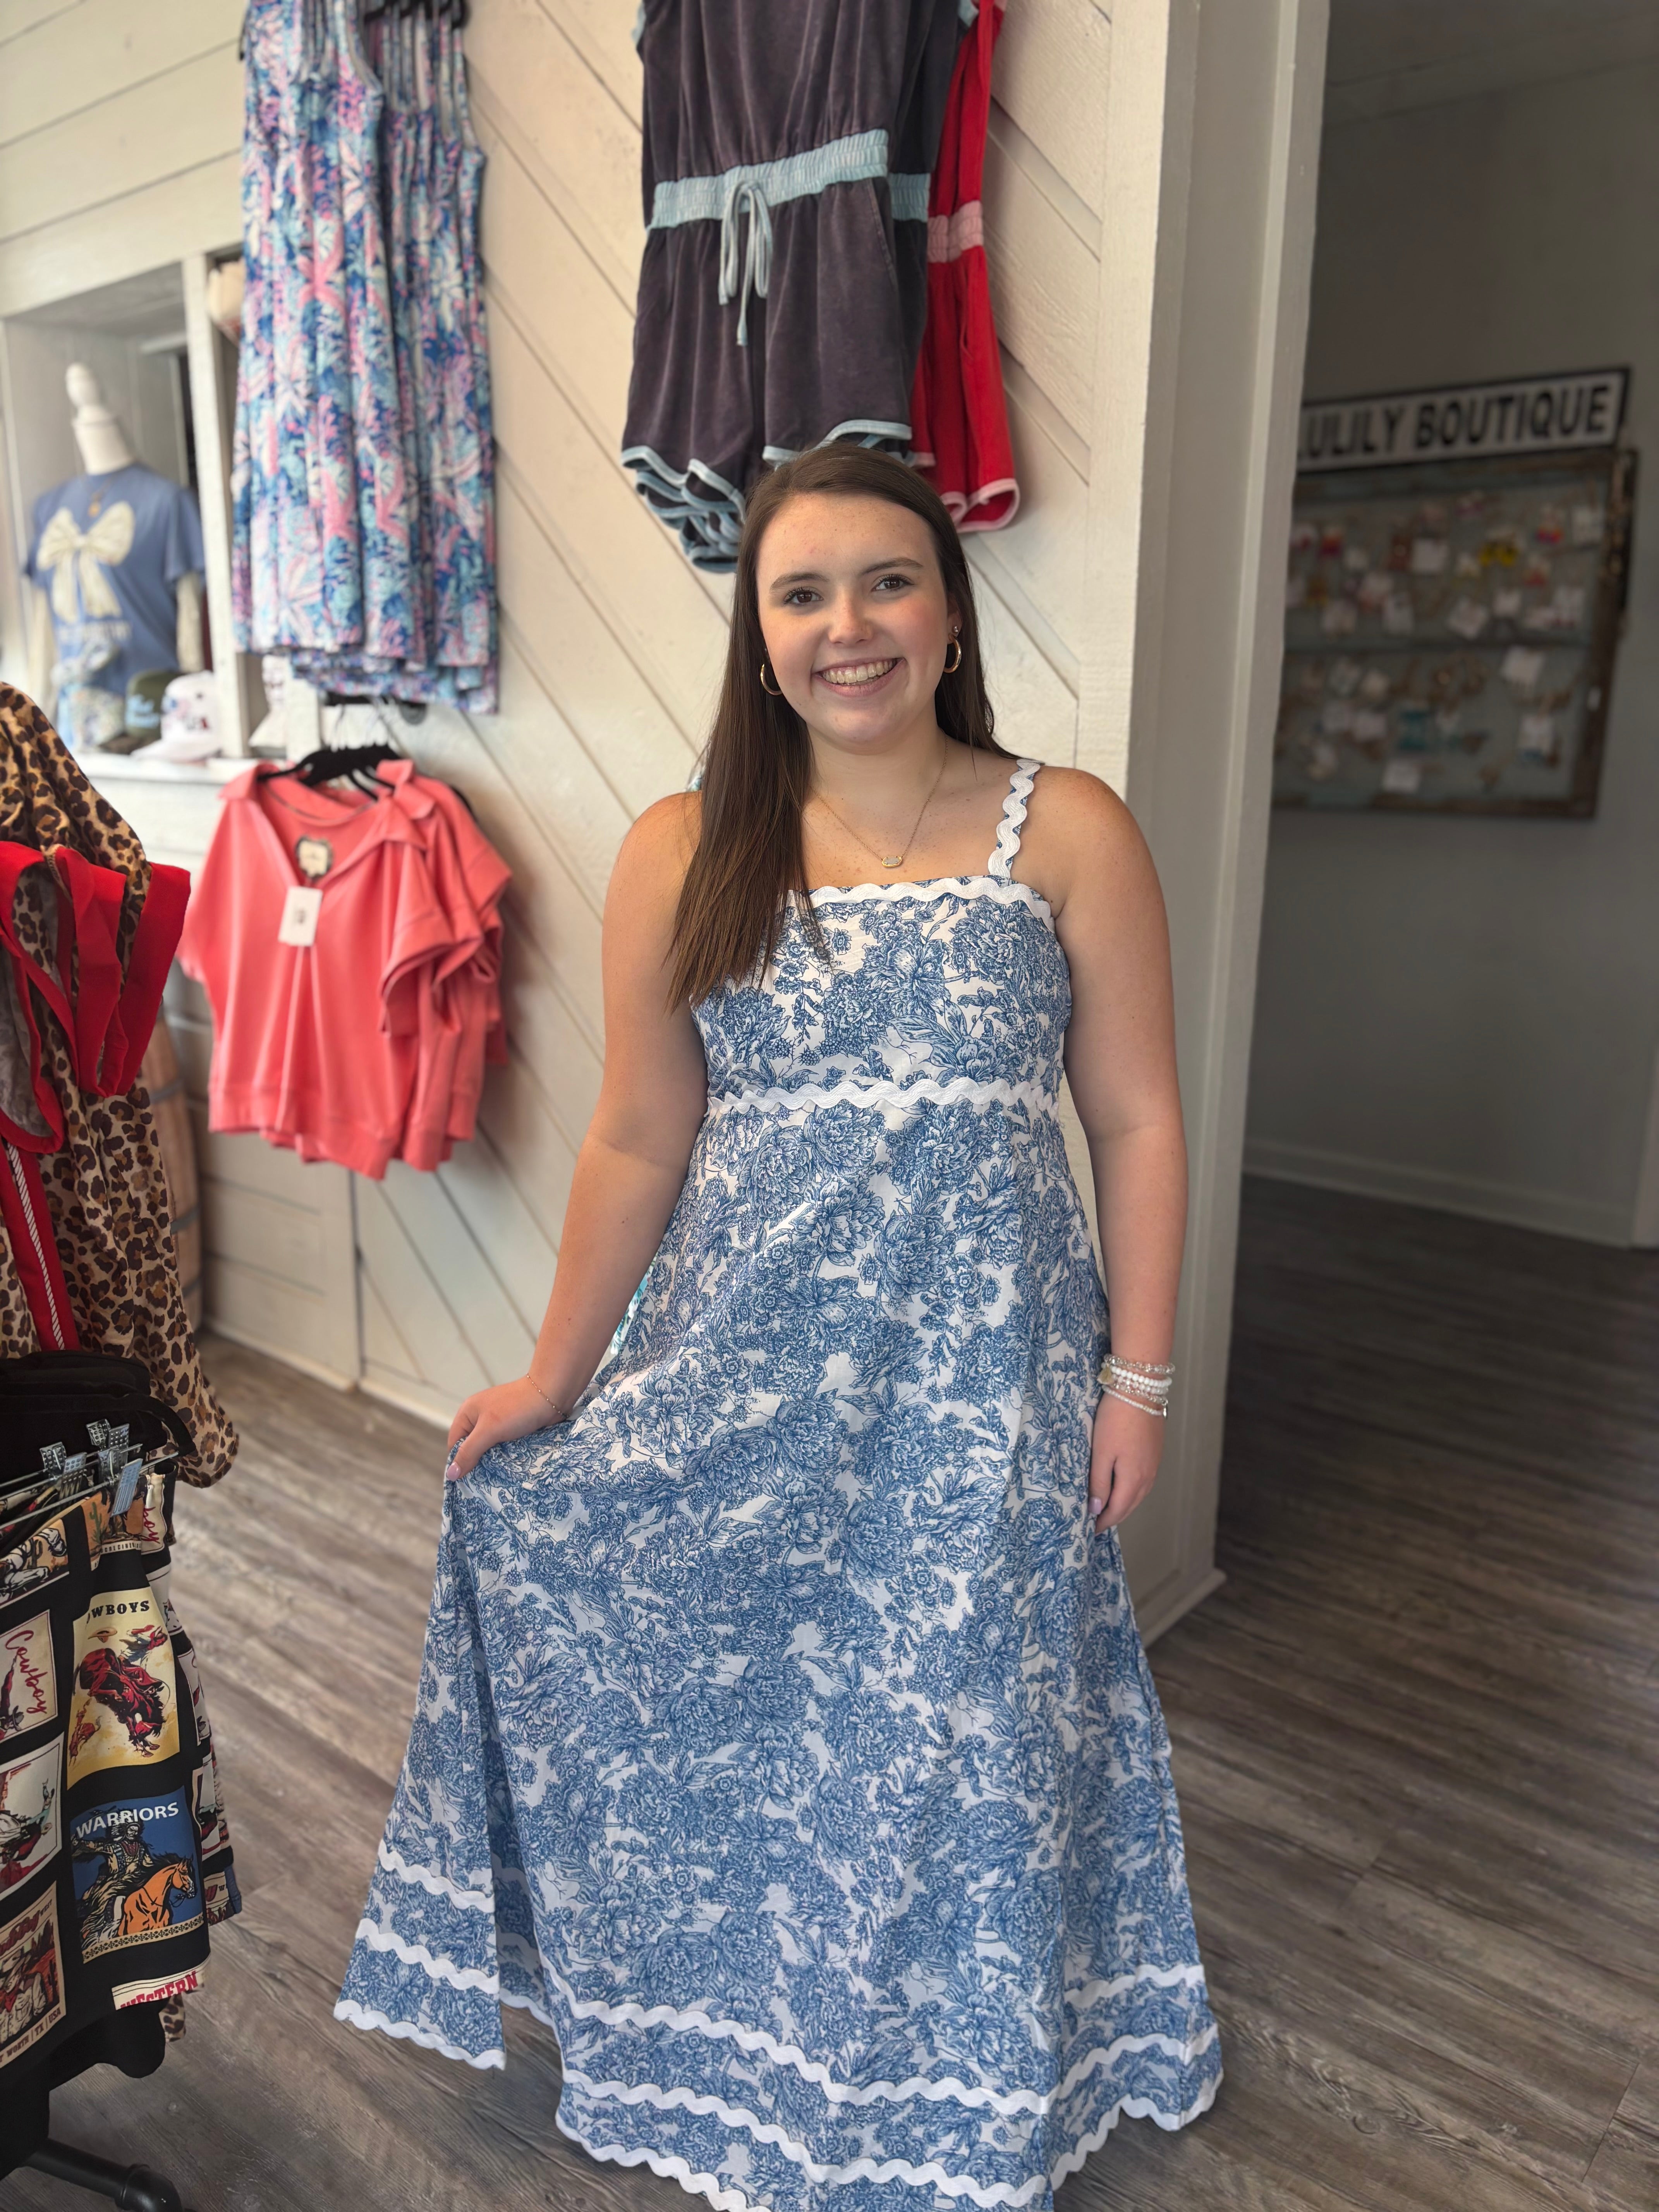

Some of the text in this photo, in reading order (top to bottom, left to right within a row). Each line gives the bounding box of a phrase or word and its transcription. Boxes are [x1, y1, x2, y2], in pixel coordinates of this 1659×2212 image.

[1298, 386, 1608, 458] ULILY BOUTIQUE
[87, 1601, 150, 1624] WBOYS
[5, 1630, 48, 1714] Cowboy
[76, 1802, 179, 1838] WARRIORS
[7, 2007, 61, 2057] WORTH TX USA
